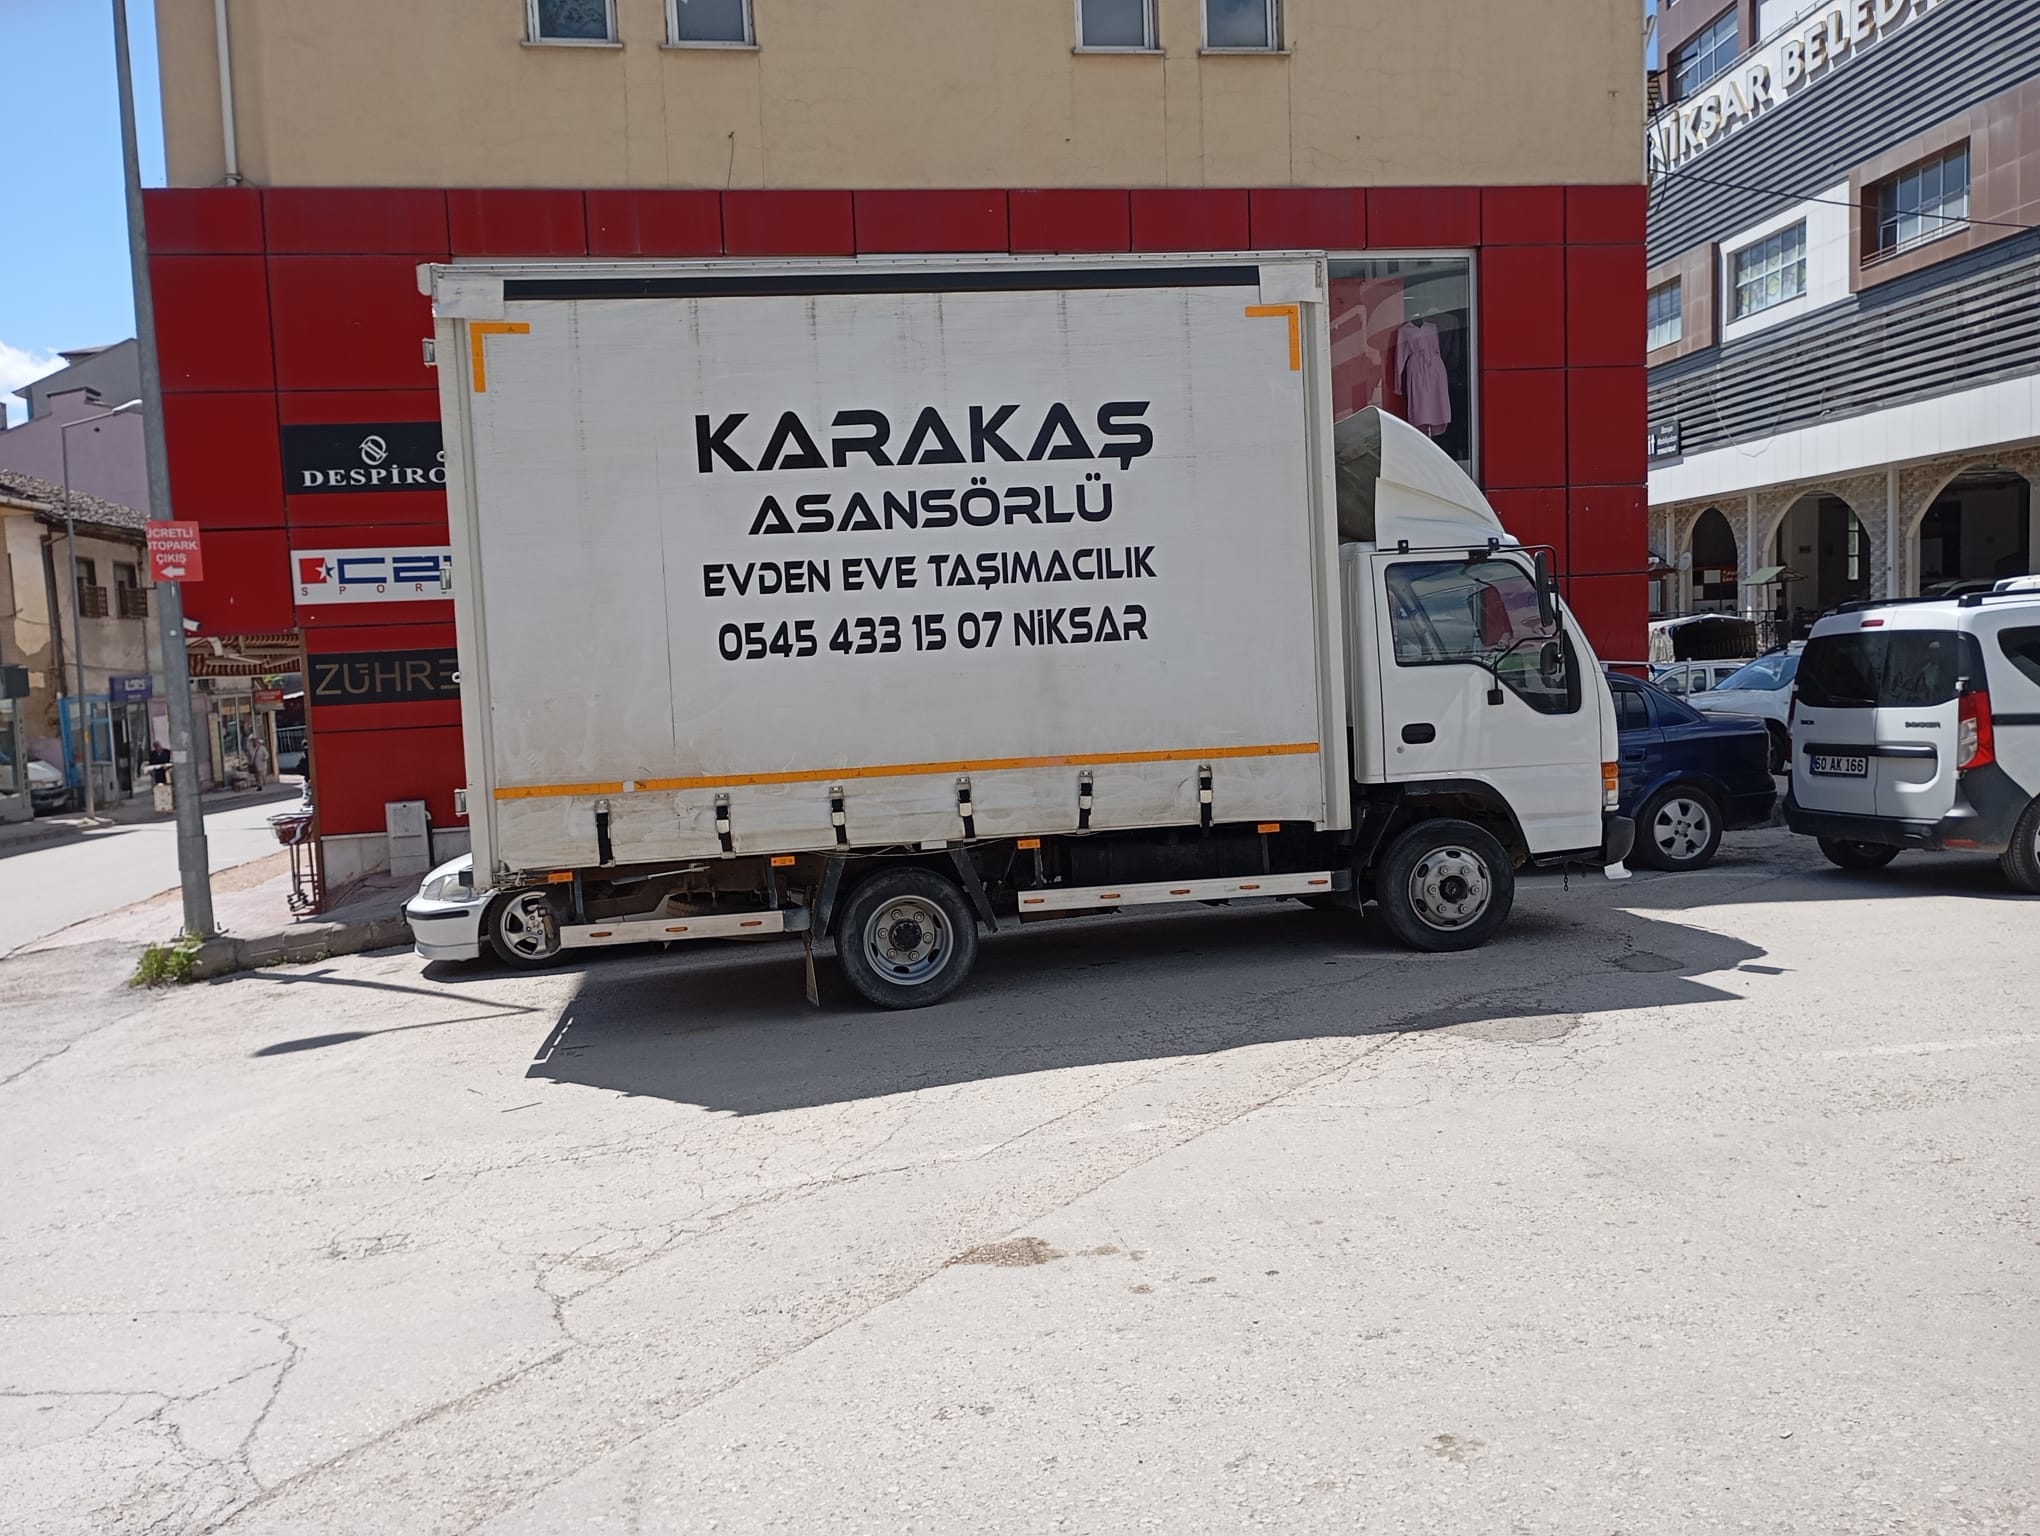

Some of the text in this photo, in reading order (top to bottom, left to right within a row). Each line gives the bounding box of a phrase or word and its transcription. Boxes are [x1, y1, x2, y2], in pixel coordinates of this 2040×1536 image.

[1780, 0, 1929, 90] BELED
[695, 402, 1153, 474] KARAKAŞ
[749, 472, 1113, 536] ASANSÖRLÜ
[704, 546, 1157, 598] EVDEN EVE TAŞIMACILIK
[719, 604, 1149, 661] 0545 433 15 07 NİKSAR
[1814, 757, 1864, 772] 60 AK 166
